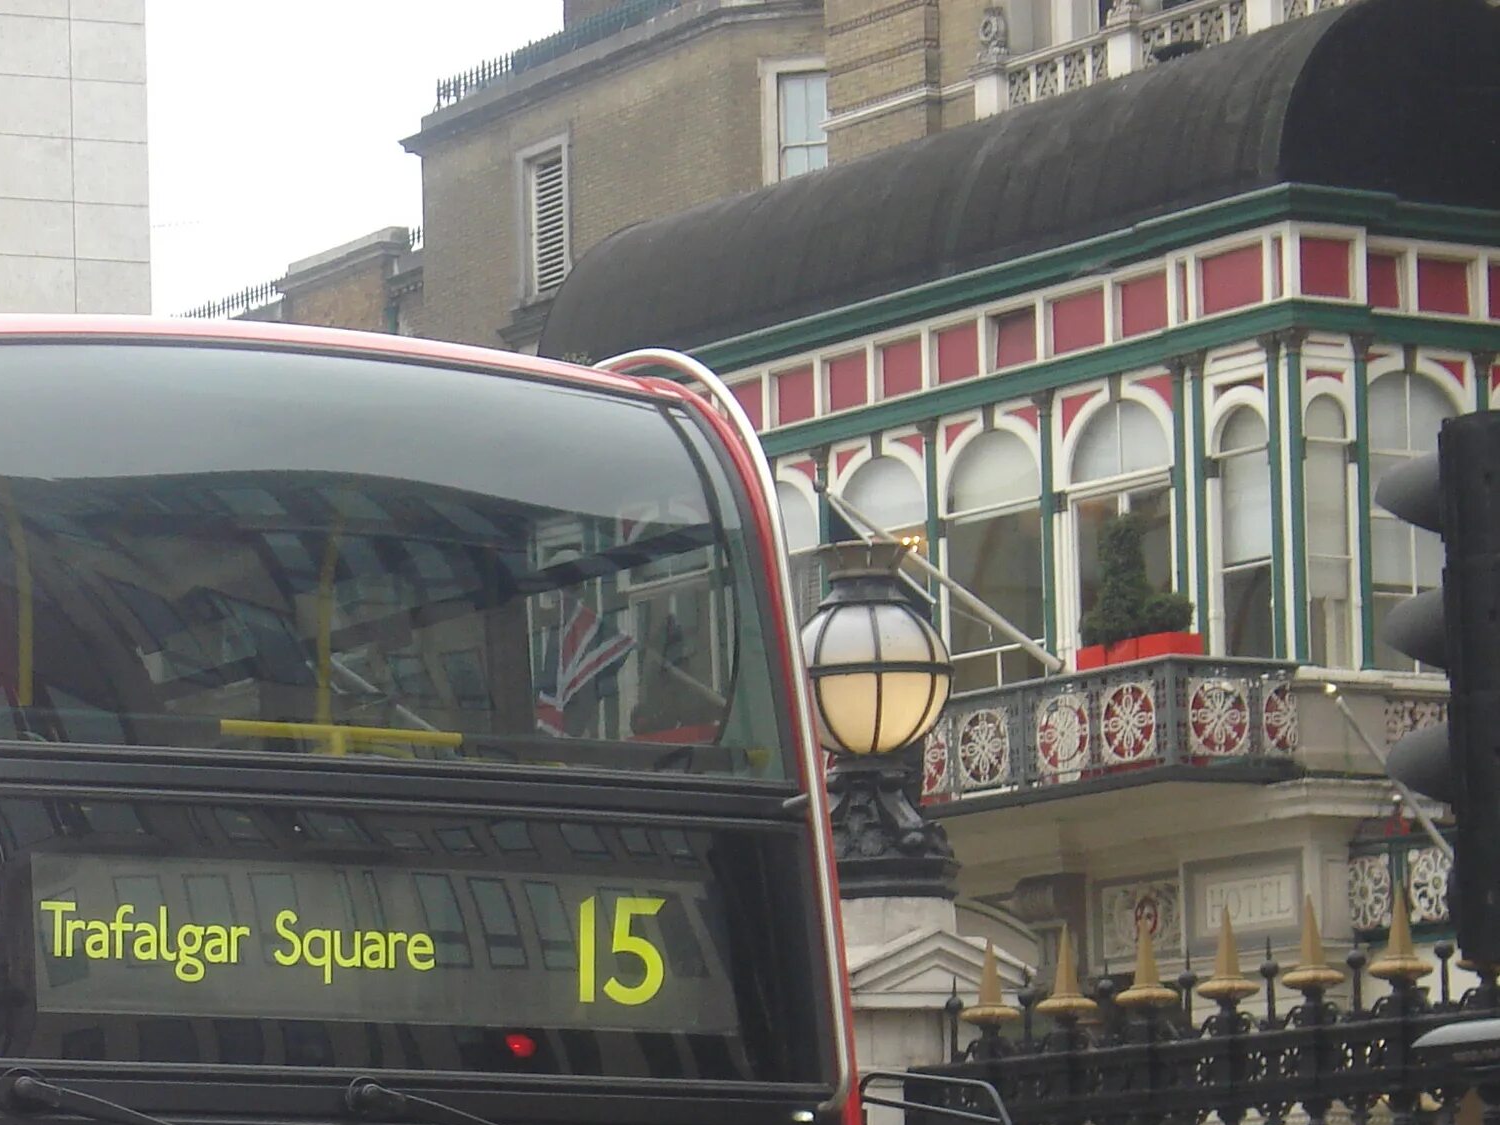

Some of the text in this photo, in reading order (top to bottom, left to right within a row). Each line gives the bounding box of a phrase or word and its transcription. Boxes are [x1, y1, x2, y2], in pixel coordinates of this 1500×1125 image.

[41, 901, 436, 984] Trafalgar Square
[1209, 880, 1293, 924] HOTEL
[579, 896, 667, 1005] 15
